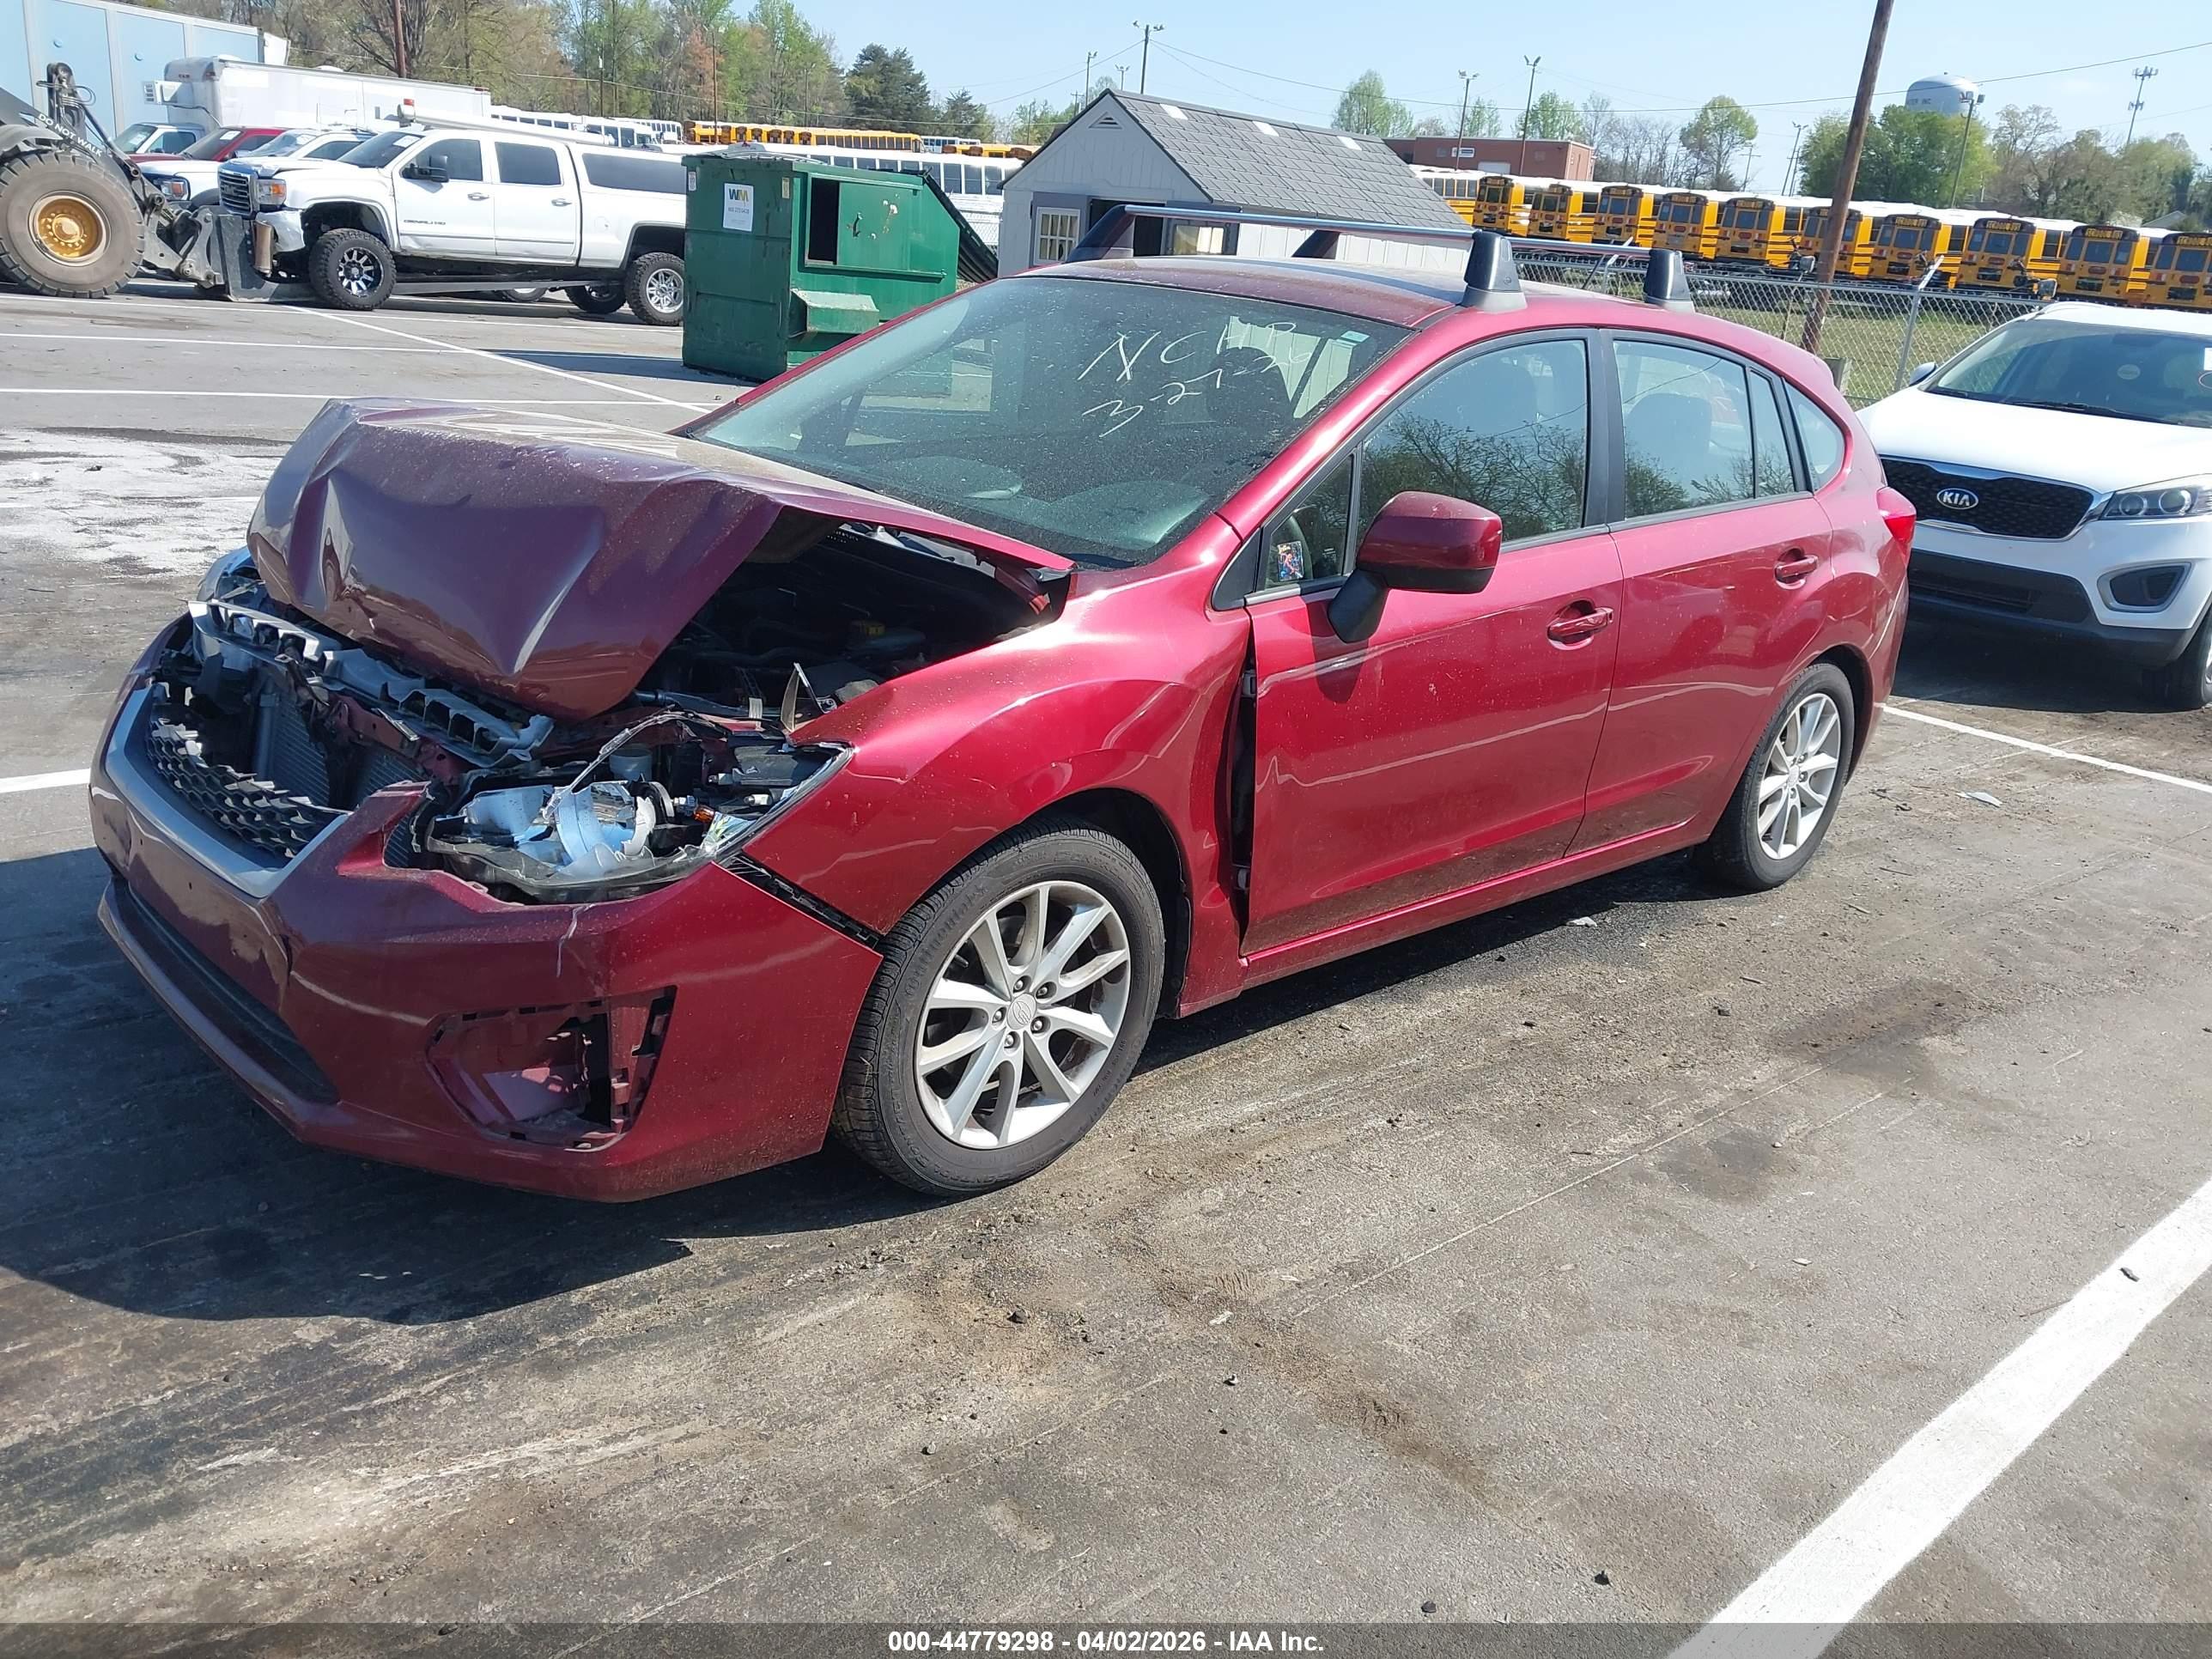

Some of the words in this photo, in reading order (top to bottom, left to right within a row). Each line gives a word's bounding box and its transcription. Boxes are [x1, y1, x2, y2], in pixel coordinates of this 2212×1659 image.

[38, 113, 54, 125] DO
[54, 124, 76, 139] NOT
[77, 137, 103, 156] WALK
[728, 188, 749, 202] WM
[1942, 491, 1970, 507] KIA
